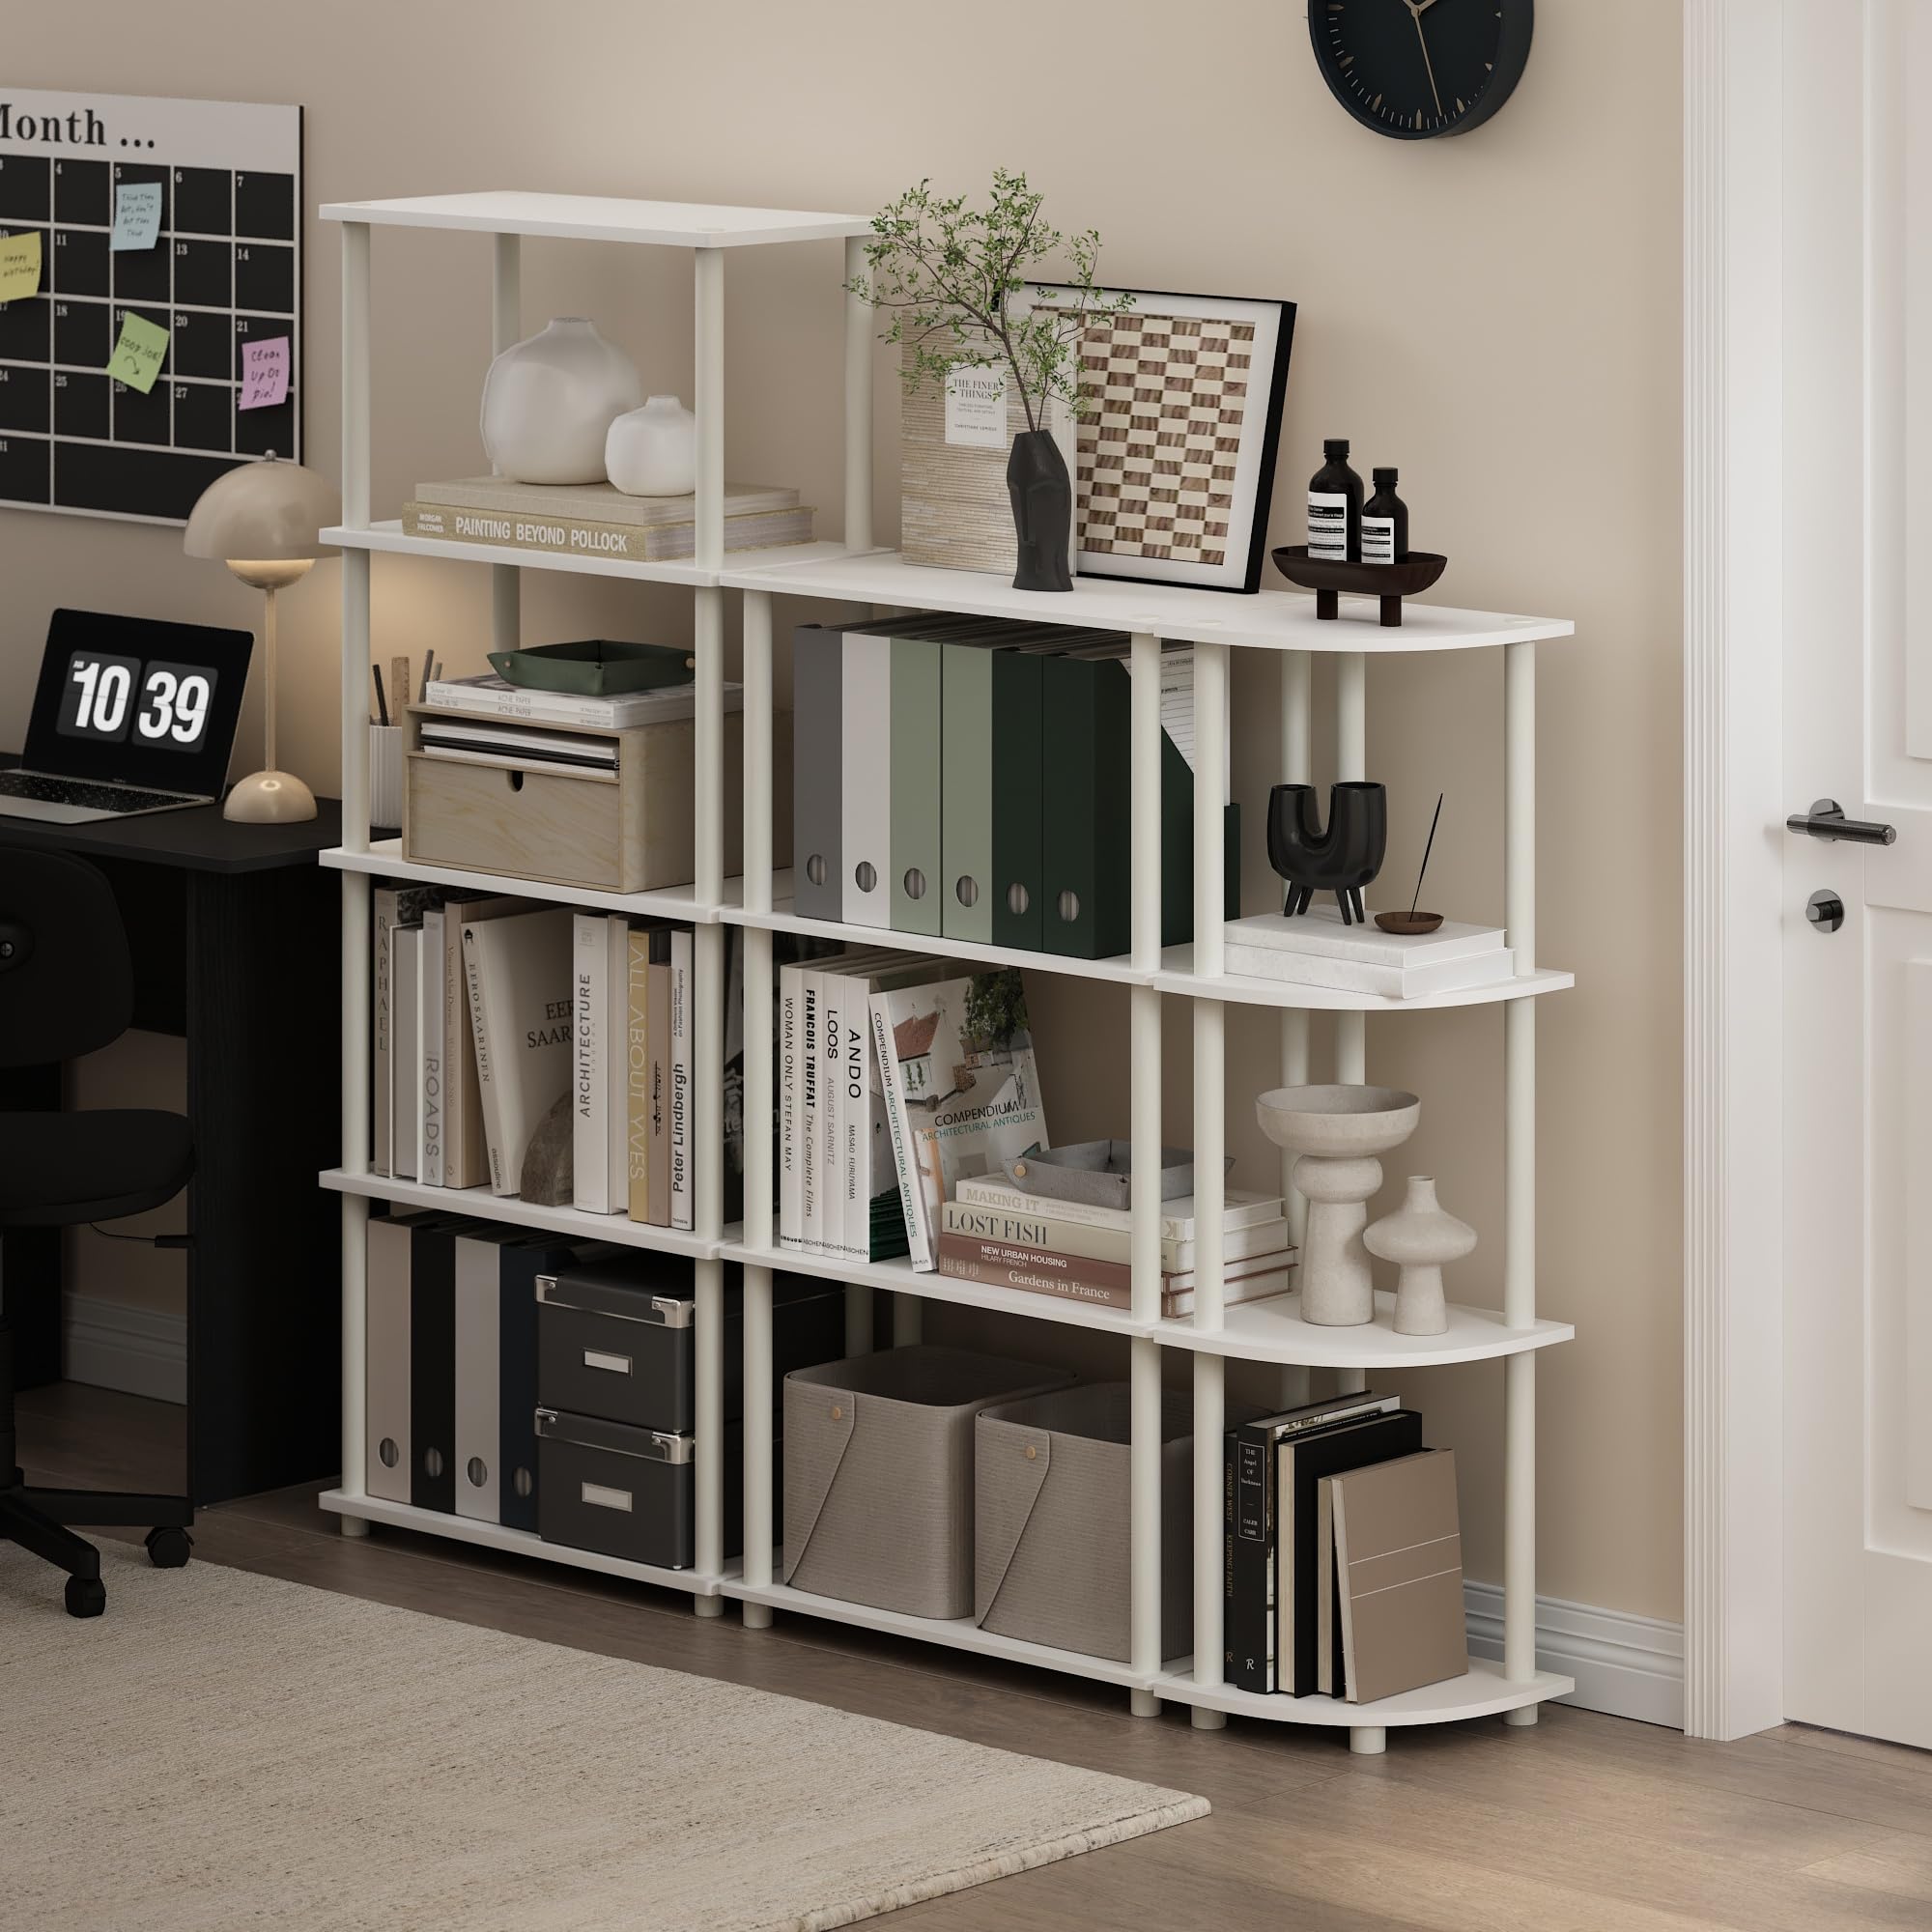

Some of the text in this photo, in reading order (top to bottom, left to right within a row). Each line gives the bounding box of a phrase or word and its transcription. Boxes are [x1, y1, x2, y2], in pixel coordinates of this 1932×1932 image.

[55, 162, 63, 175] 4
[114, 167, 122, 179] 5
[175, 172, 183, 184] 6
[237, 176, 244, 187] 7
[56, 234, 67, 245] 11
[176, 243, 188, 255] 13
[237, 248, 249, 260] 14
[56, 304, 68, 317] 18
[175, 315, 187, 327] 20
[236, 321, 248, 332] 21
[55, 376, 68, 387] 25
[175, 386, 187, 398] 27
[959, 388, 992, 399] THINGS
[455, 516, 628, 552] PAINTING BEYOND POLLOCK
[72, 662, 210, 743] 10 39
[784, 997, 793, 1050] WOMAN
[827, 1009, 838, 1060] LOOS
[527, 1025, 574, 1048] SAAR
[580, 973, 591, 1119] ARCHITECTURE
[629, 943, 645, 1180] ALL ABOUT YVES
[784, 1055, 793, 1091] ONLY
[848, 1029, 862, 1099] ANDO
[425, 1057, 440, 1157] ROADS
[806, 989, 815, 1217] FRANCOIS TRUFFAT The Complete Films
[934, 1100, 1019, 1127] COMPENDIUM
[673, 1064, 687, 1193] Peter Lindbergh
[874, 1012, 918, 1237] COMPENDIUM ARCHITECTURAL ANTIQUES
[922, 1111, 1036, 1142] ARCHITECTURAL ANTIQUES
[827, 1122, 836, 1166] SARNITZ
[491, 1148, 501, 1189] assouline
[966, 1188, 1021, 1208] MAKING
[1026, 1198, 1039, 1212] IT
[949, 1209, 1047, 1245] LOST FISH
[980, 1245, 1067, 1268] NEW URBAN HOUSING
[980, 1253, 1027, 1267] HILARY FRENCH
[1009, 1269, 1110, 1299] Gardens in France
[1245, 1658, 1255, 1670] R
